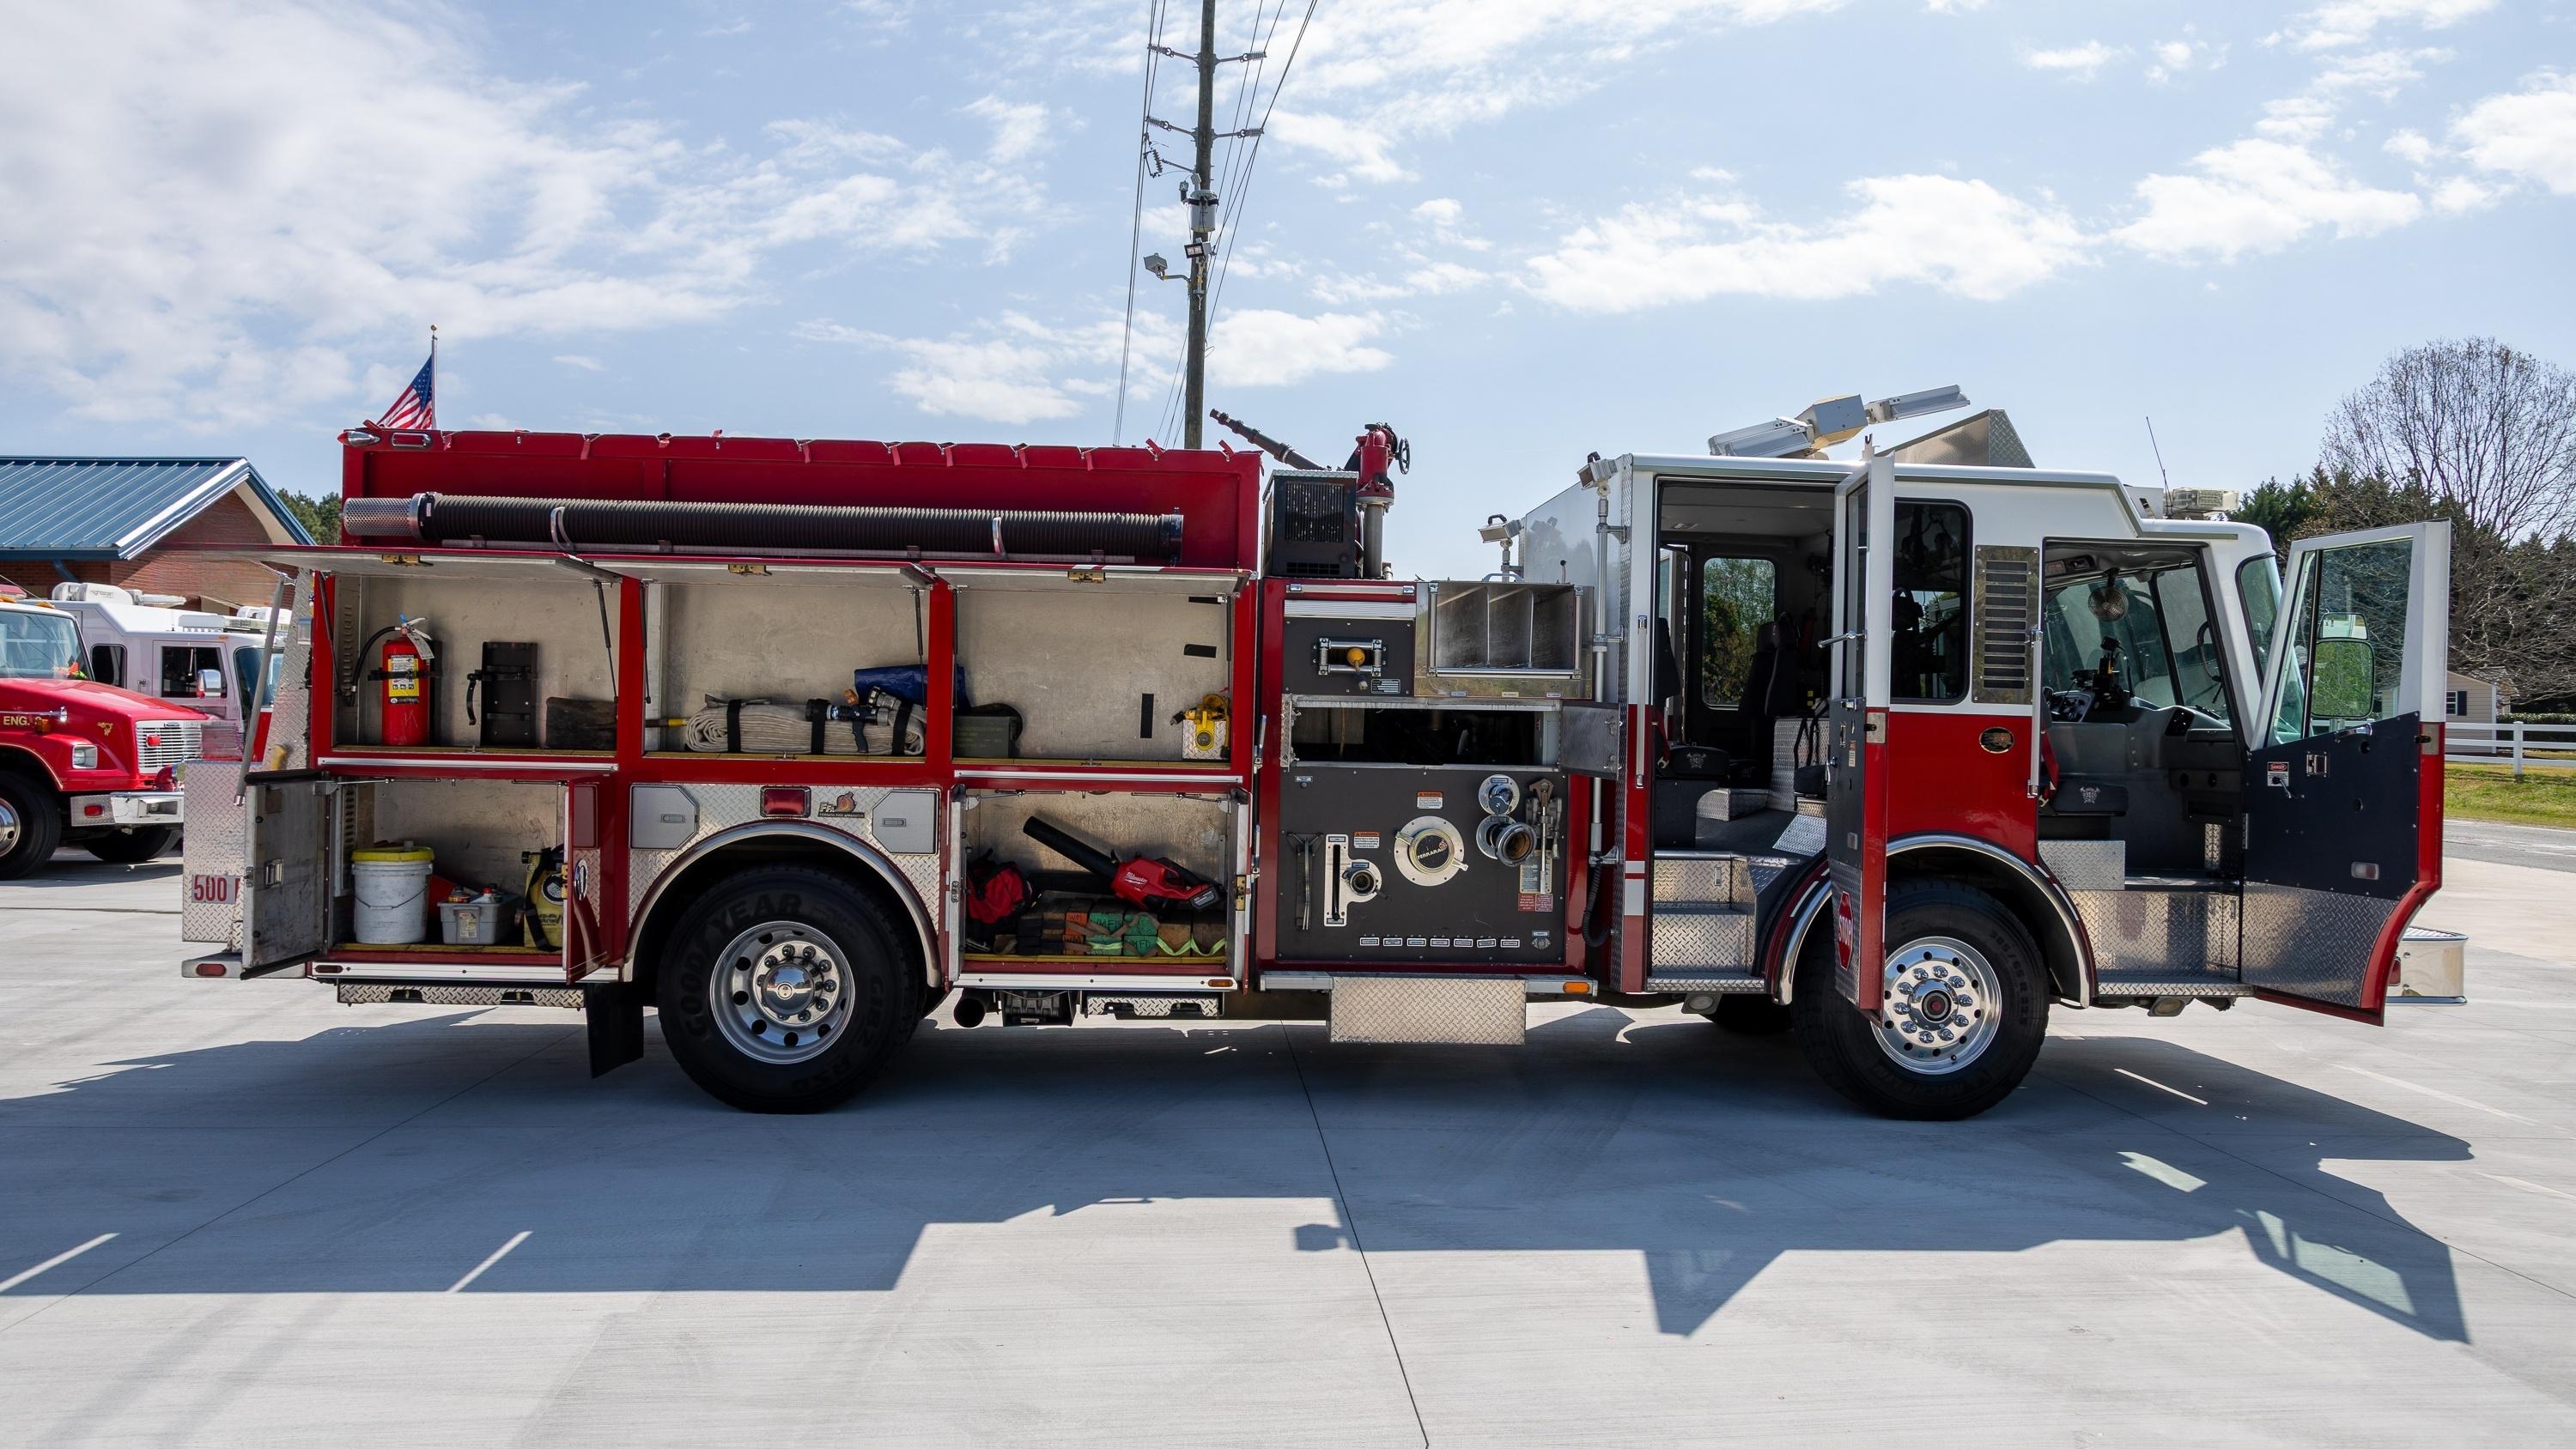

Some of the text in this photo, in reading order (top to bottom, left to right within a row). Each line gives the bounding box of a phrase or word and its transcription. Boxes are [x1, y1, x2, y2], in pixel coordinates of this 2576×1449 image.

[3, 716, 30, 726] ENG.
[1418, 848, 1442, 860] FERRARA
[194, 875, 228, 901] 500
[1839, 914, 1853, 947] STOP
[680, 893, 803, 1039] GOODYEAR
